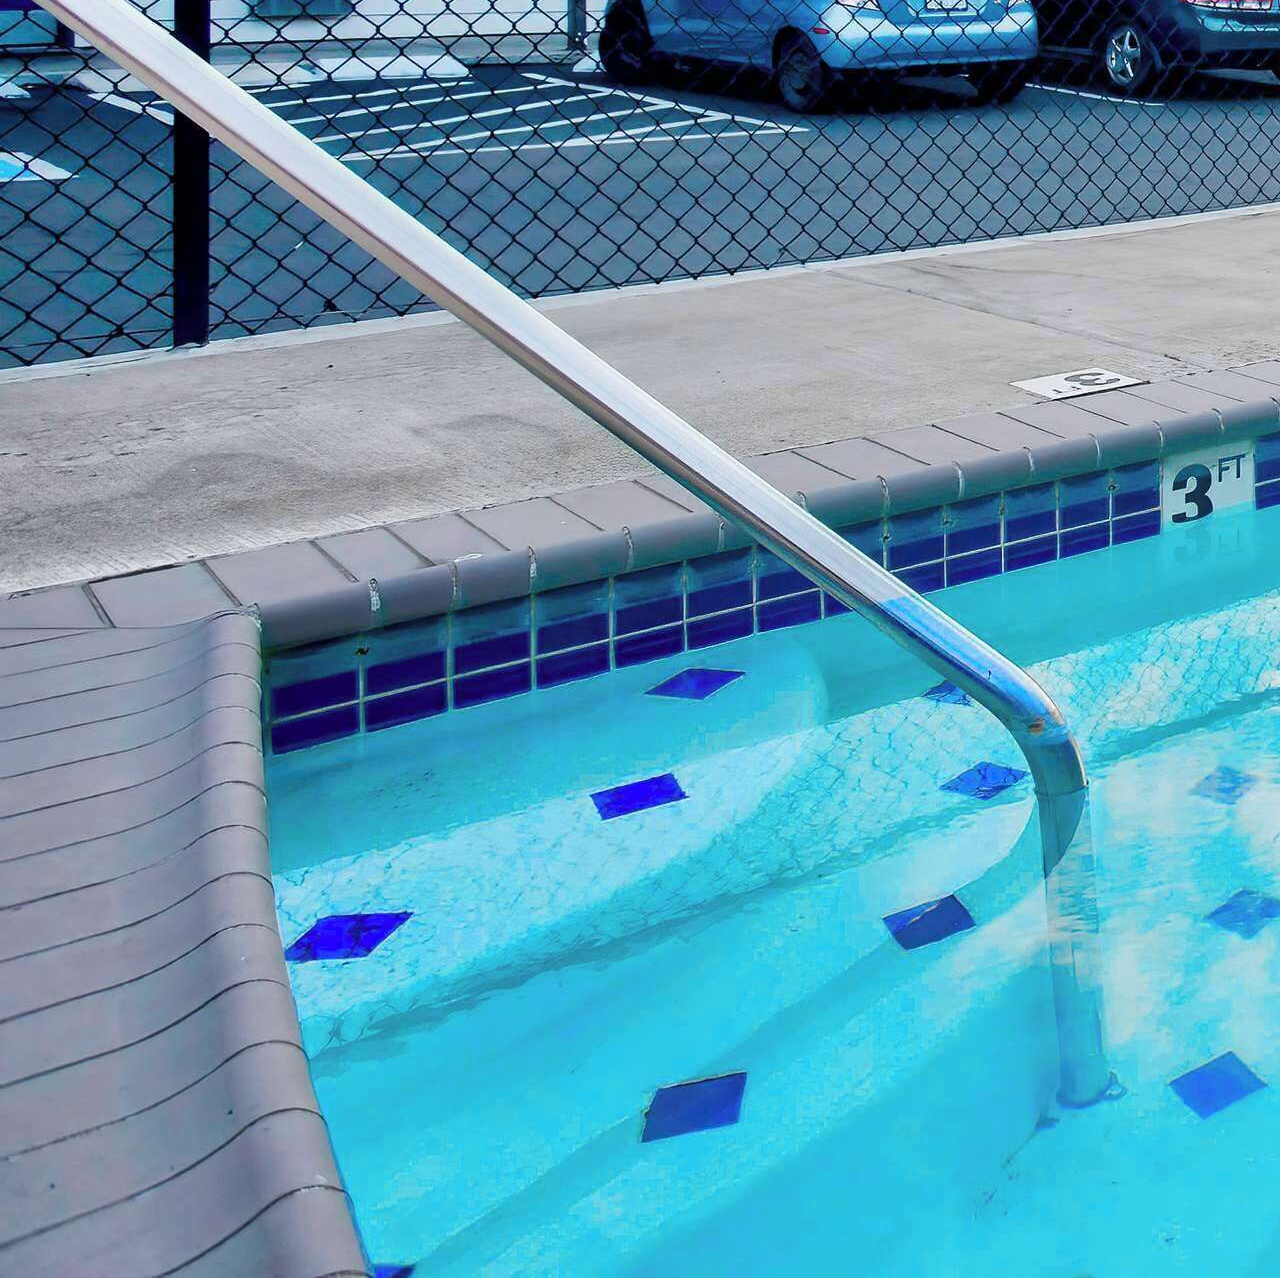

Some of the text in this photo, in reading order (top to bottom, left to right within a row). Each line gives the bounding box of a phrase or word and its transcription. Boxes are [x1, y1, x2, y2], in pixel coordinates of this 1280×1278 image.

[1064, 371, 1121, 387] 3
[1172, 453, 1246, 524] 3 FT
